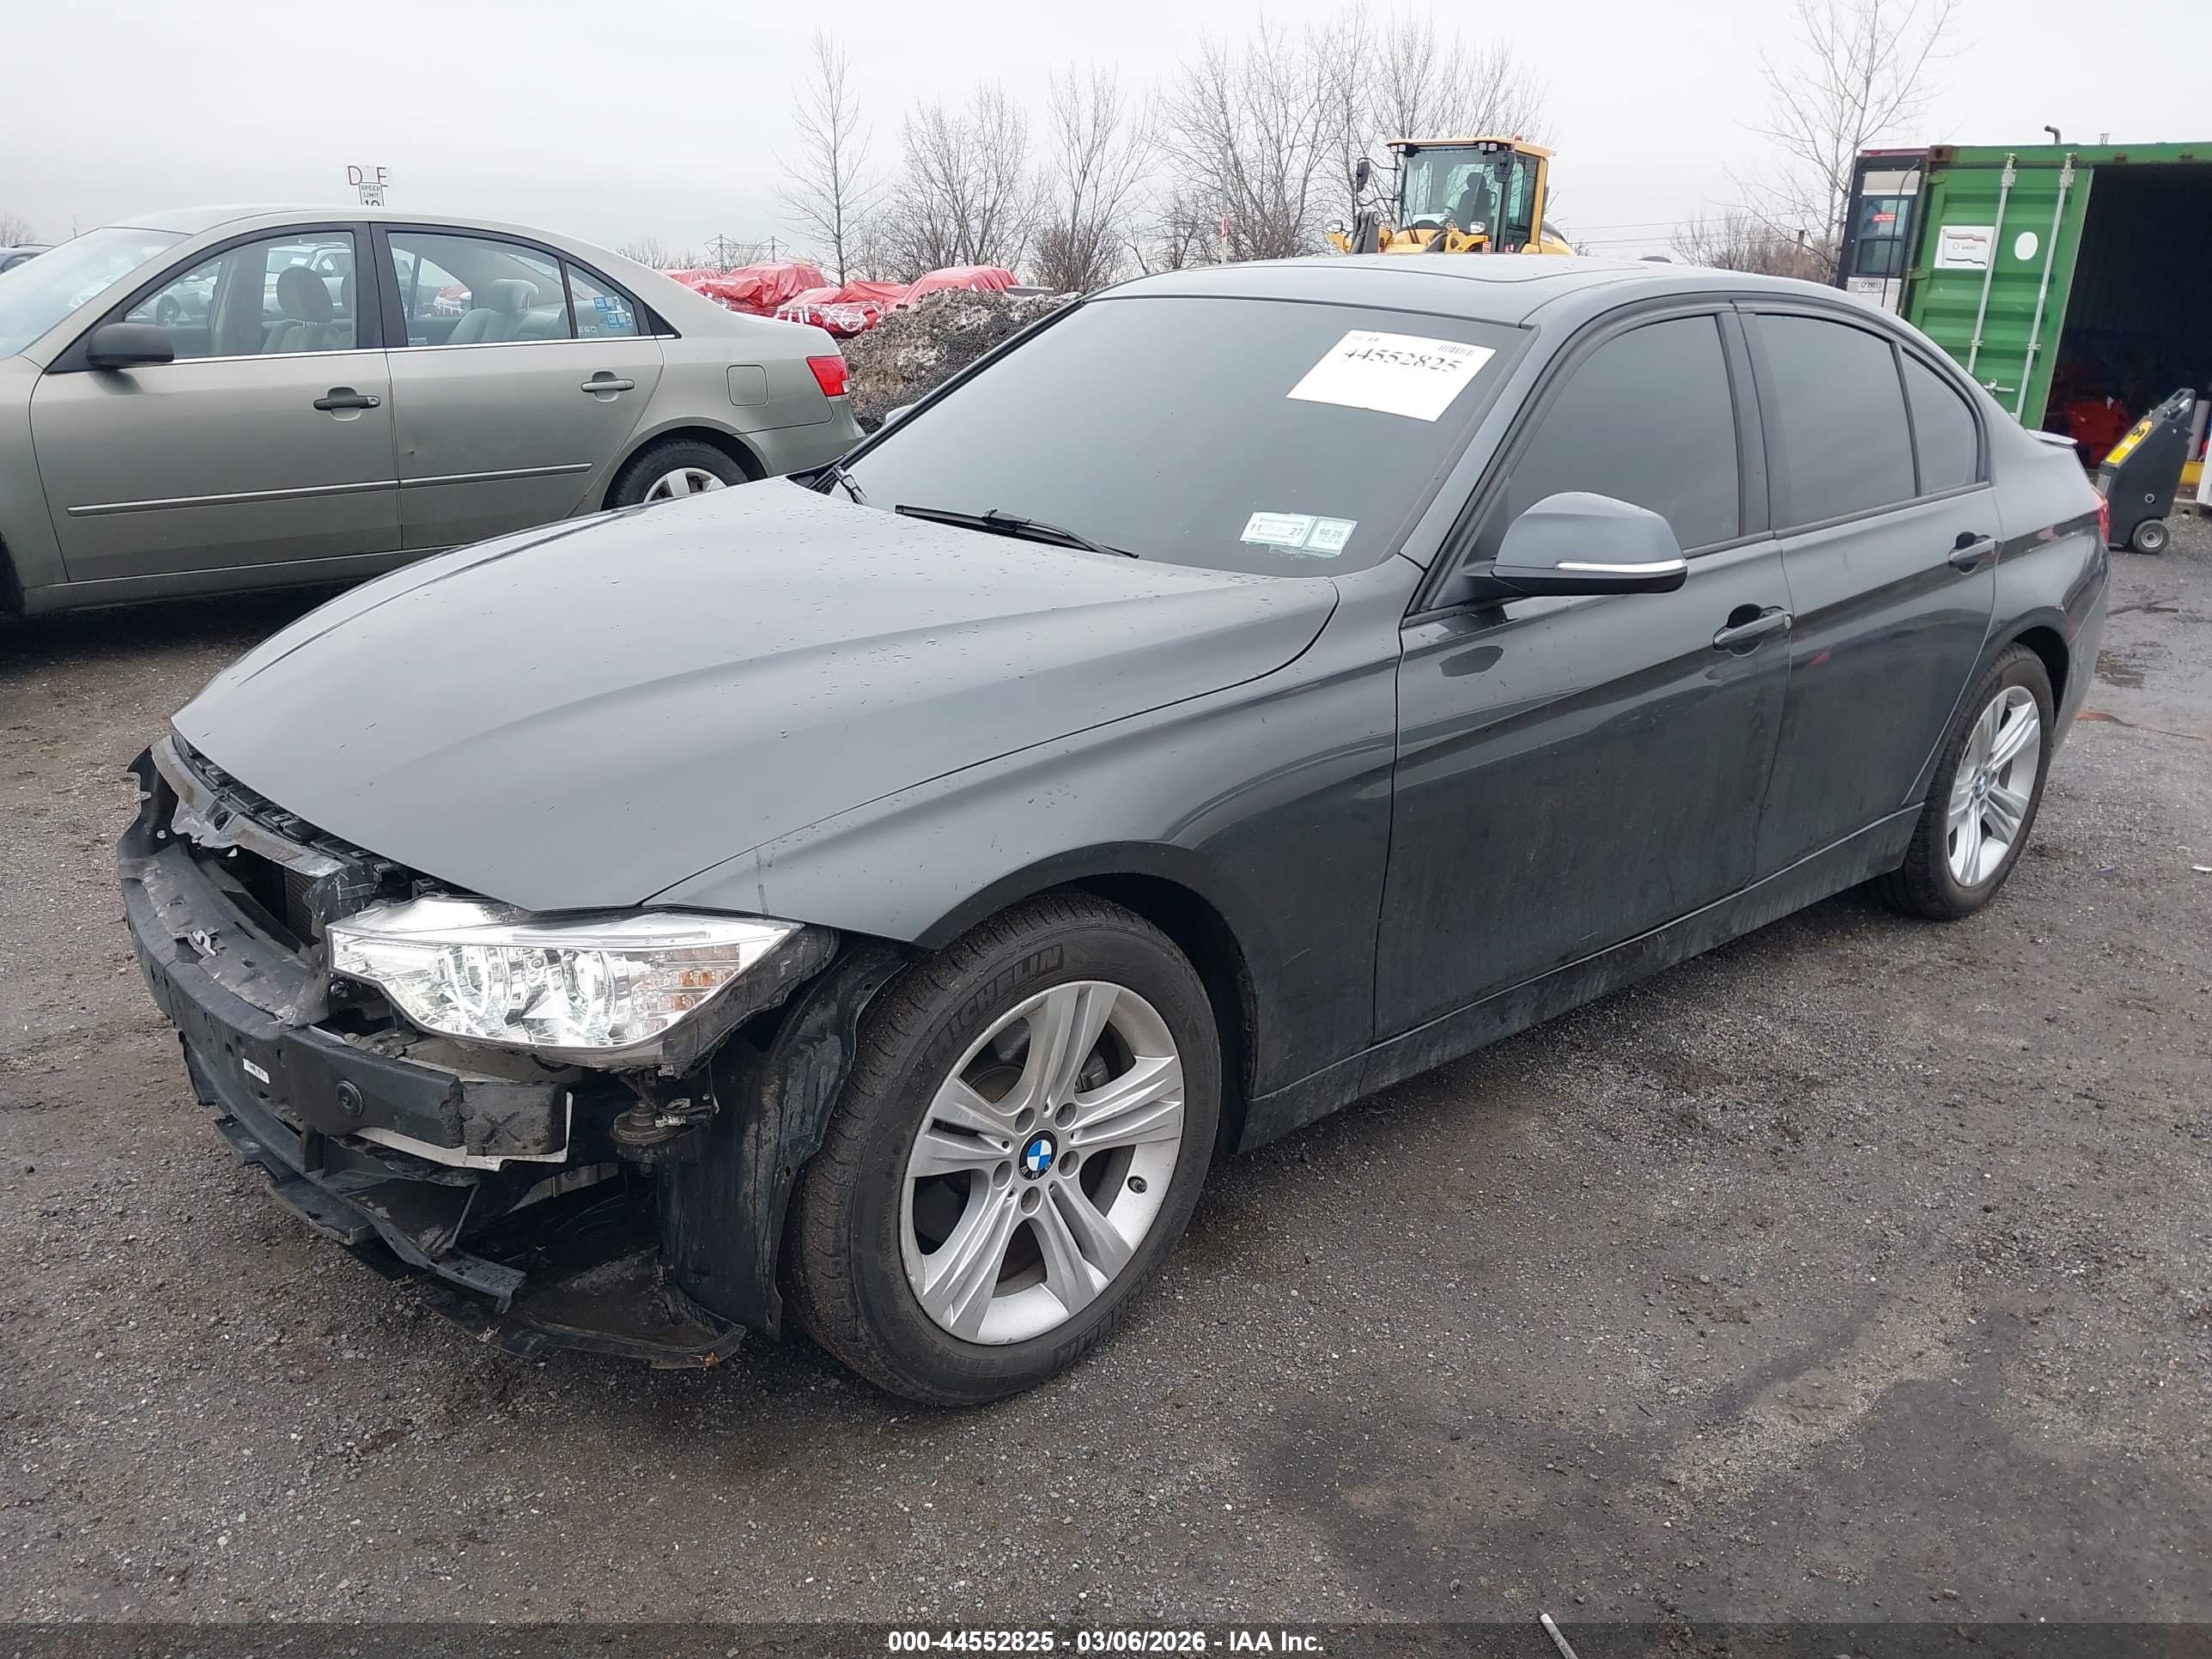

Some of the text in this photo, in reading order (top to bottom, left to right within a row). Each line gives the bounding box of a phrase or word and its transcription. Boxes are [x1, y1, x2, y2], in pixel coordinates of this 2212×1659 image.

[1344, 347, 1463, 373] 44552825
[1289, 527, 1305, 537] 27
[925, 943, 1064, 1063] MICHELIN
